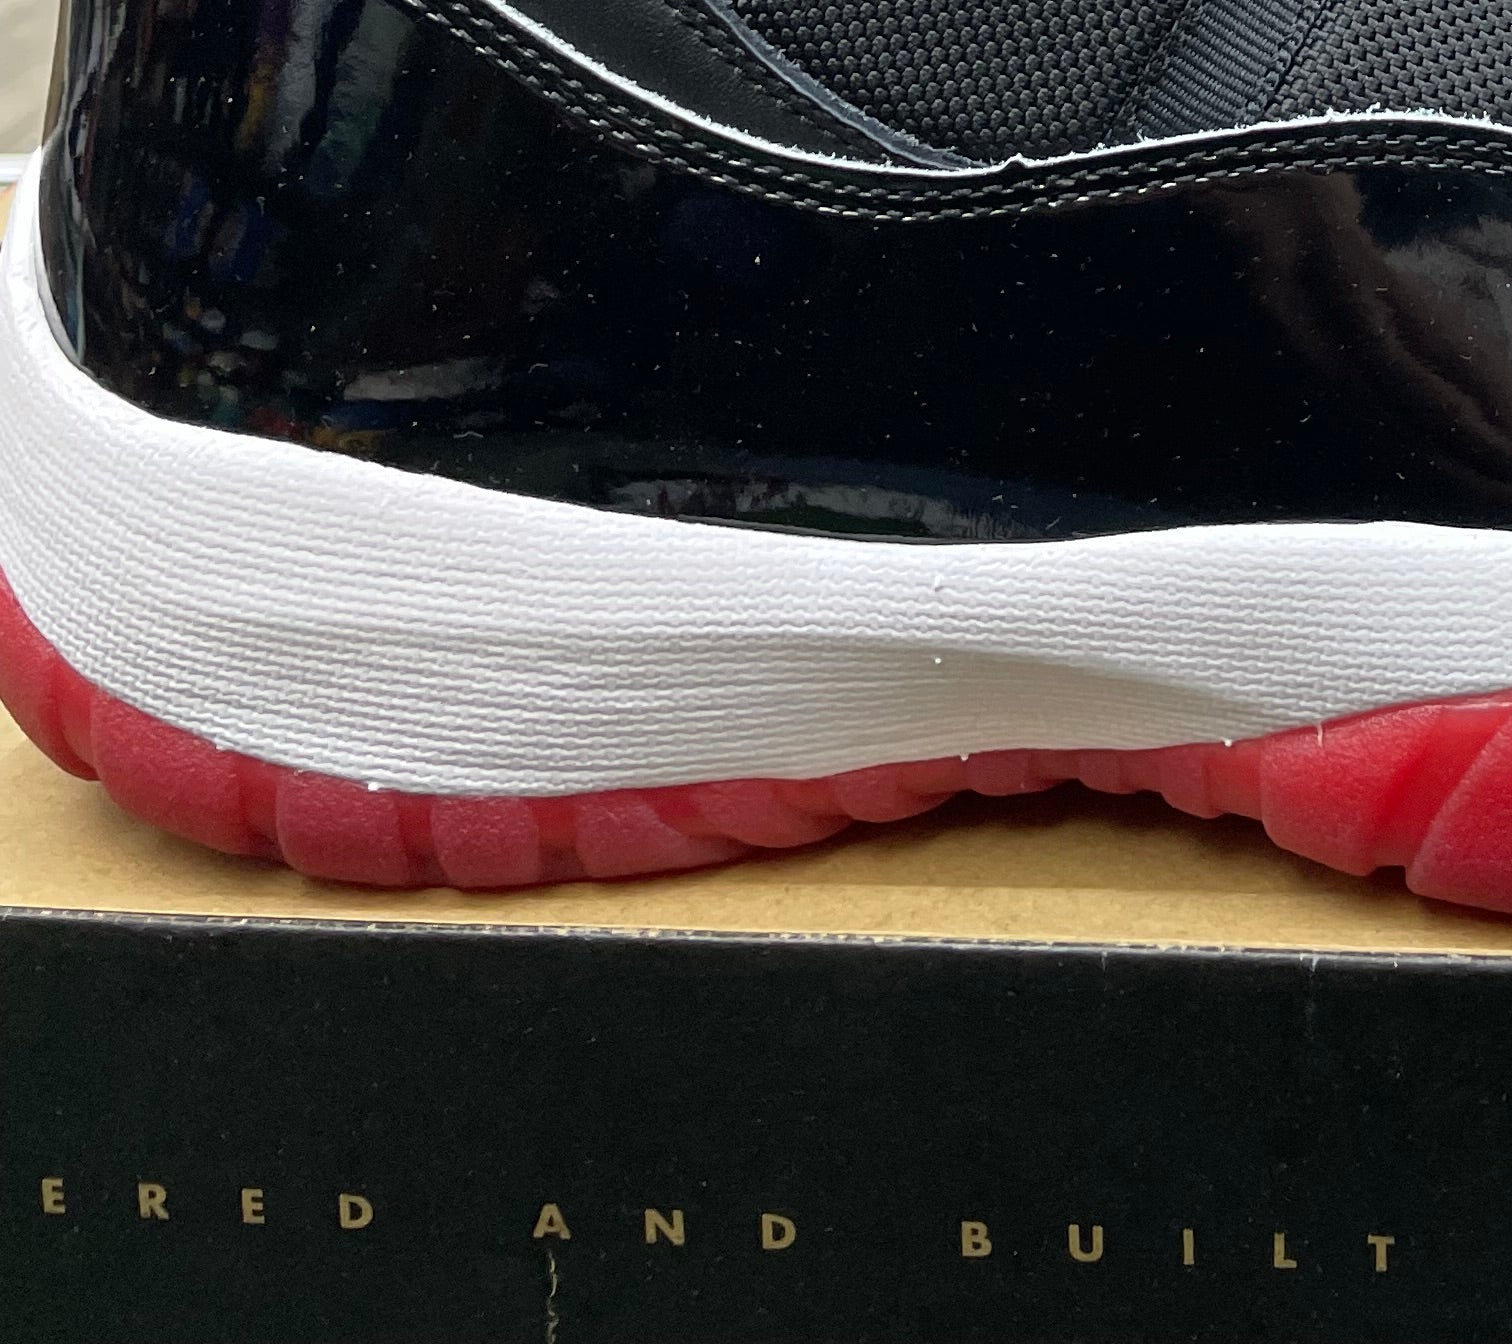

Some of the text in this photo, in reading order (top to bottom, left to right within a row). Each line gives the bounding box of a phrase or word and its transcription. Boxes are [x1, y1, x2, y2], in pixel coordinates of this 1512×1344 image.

[40, 1177, 374, 1230] ERED
[532, 1203, 797, 1250] AND
[960, 1220, 1395, 1272] BUILT
